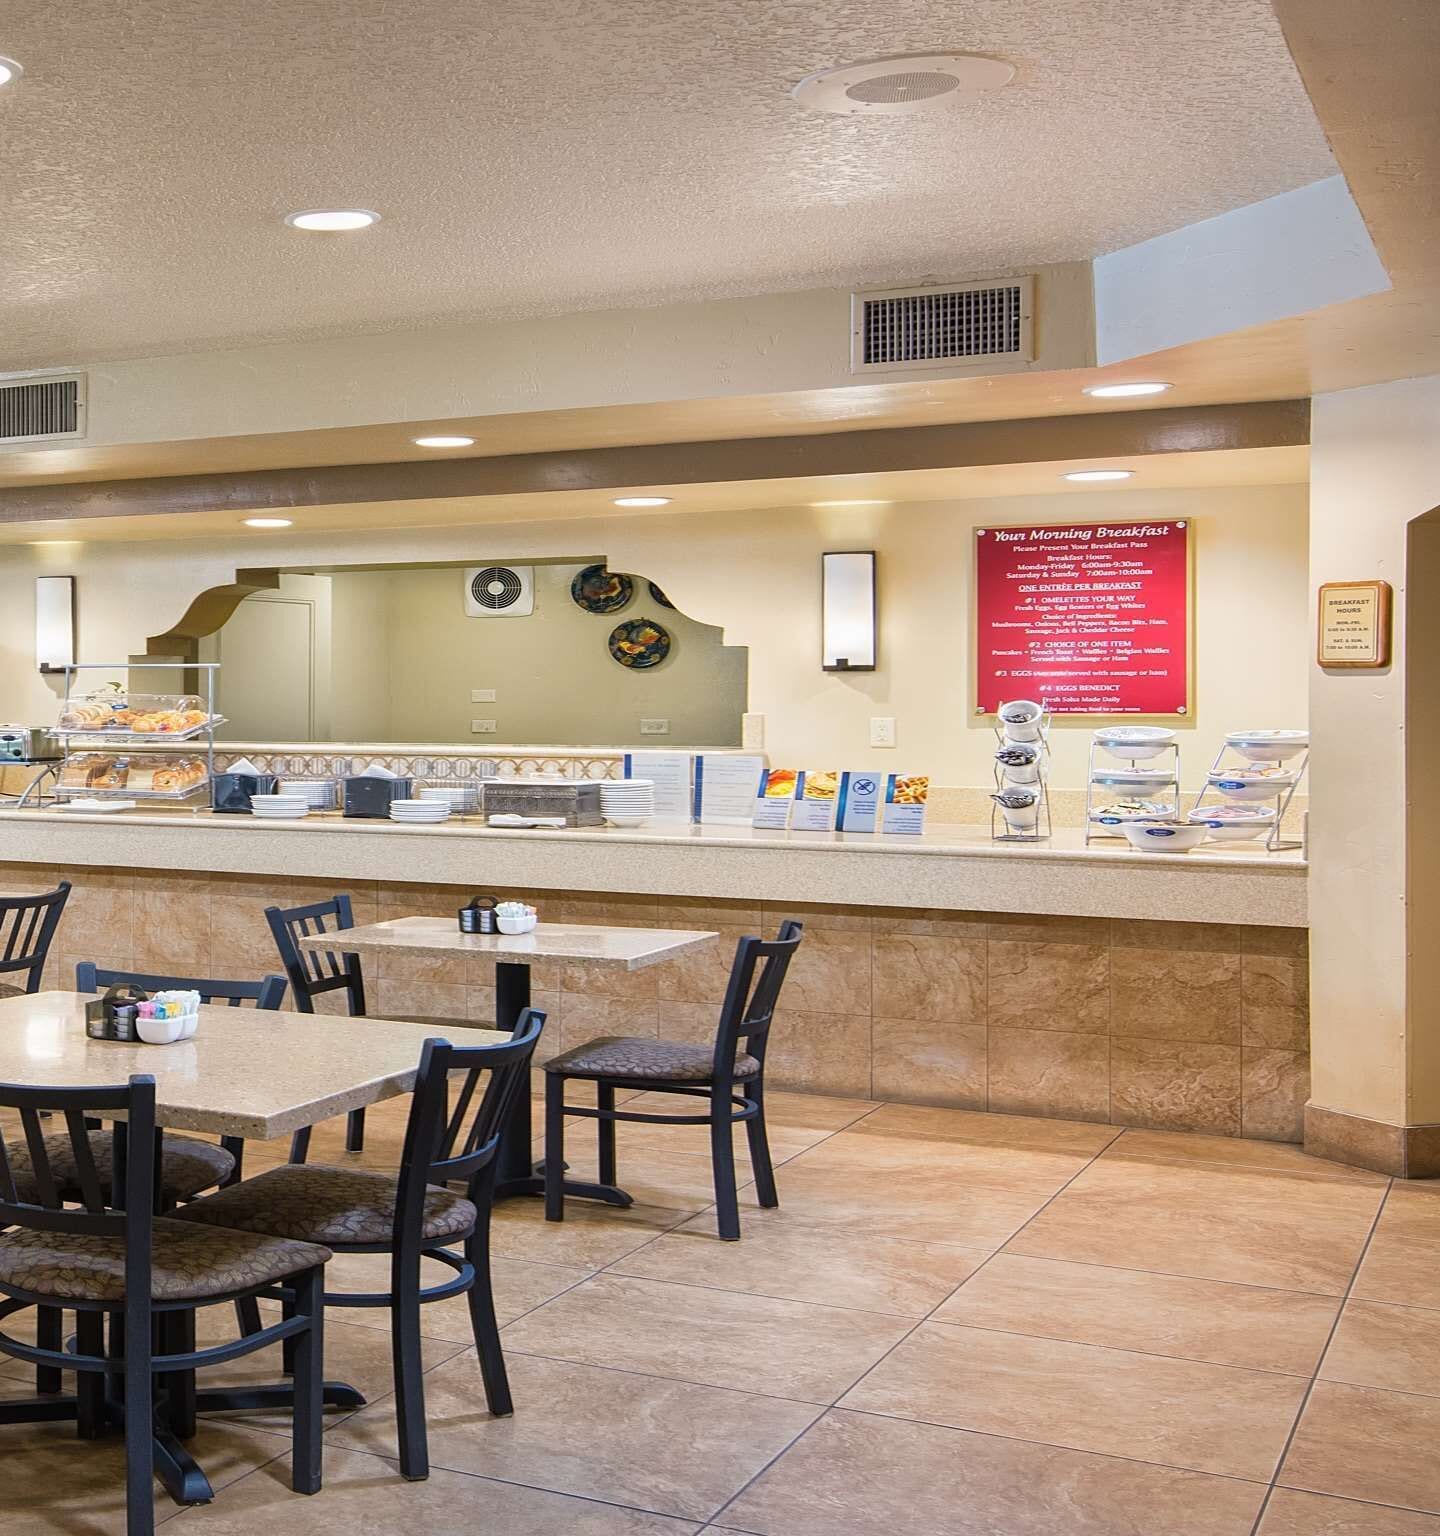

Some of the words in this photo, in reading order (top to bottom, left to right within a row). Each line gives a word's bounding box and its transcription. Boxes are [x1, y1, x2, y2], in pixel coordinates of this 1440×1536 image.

[994, 531, 1026, 542] Your
[1029, 528, 1092, 541] Morning
[1096, 525, 1169, 538] Breakfast
[1017, 562, 1075, 570] Monday-Friday
[1006, 571, 1041, 580] Saturday
[1092, 582, 1143, 590] BREAKFAST
